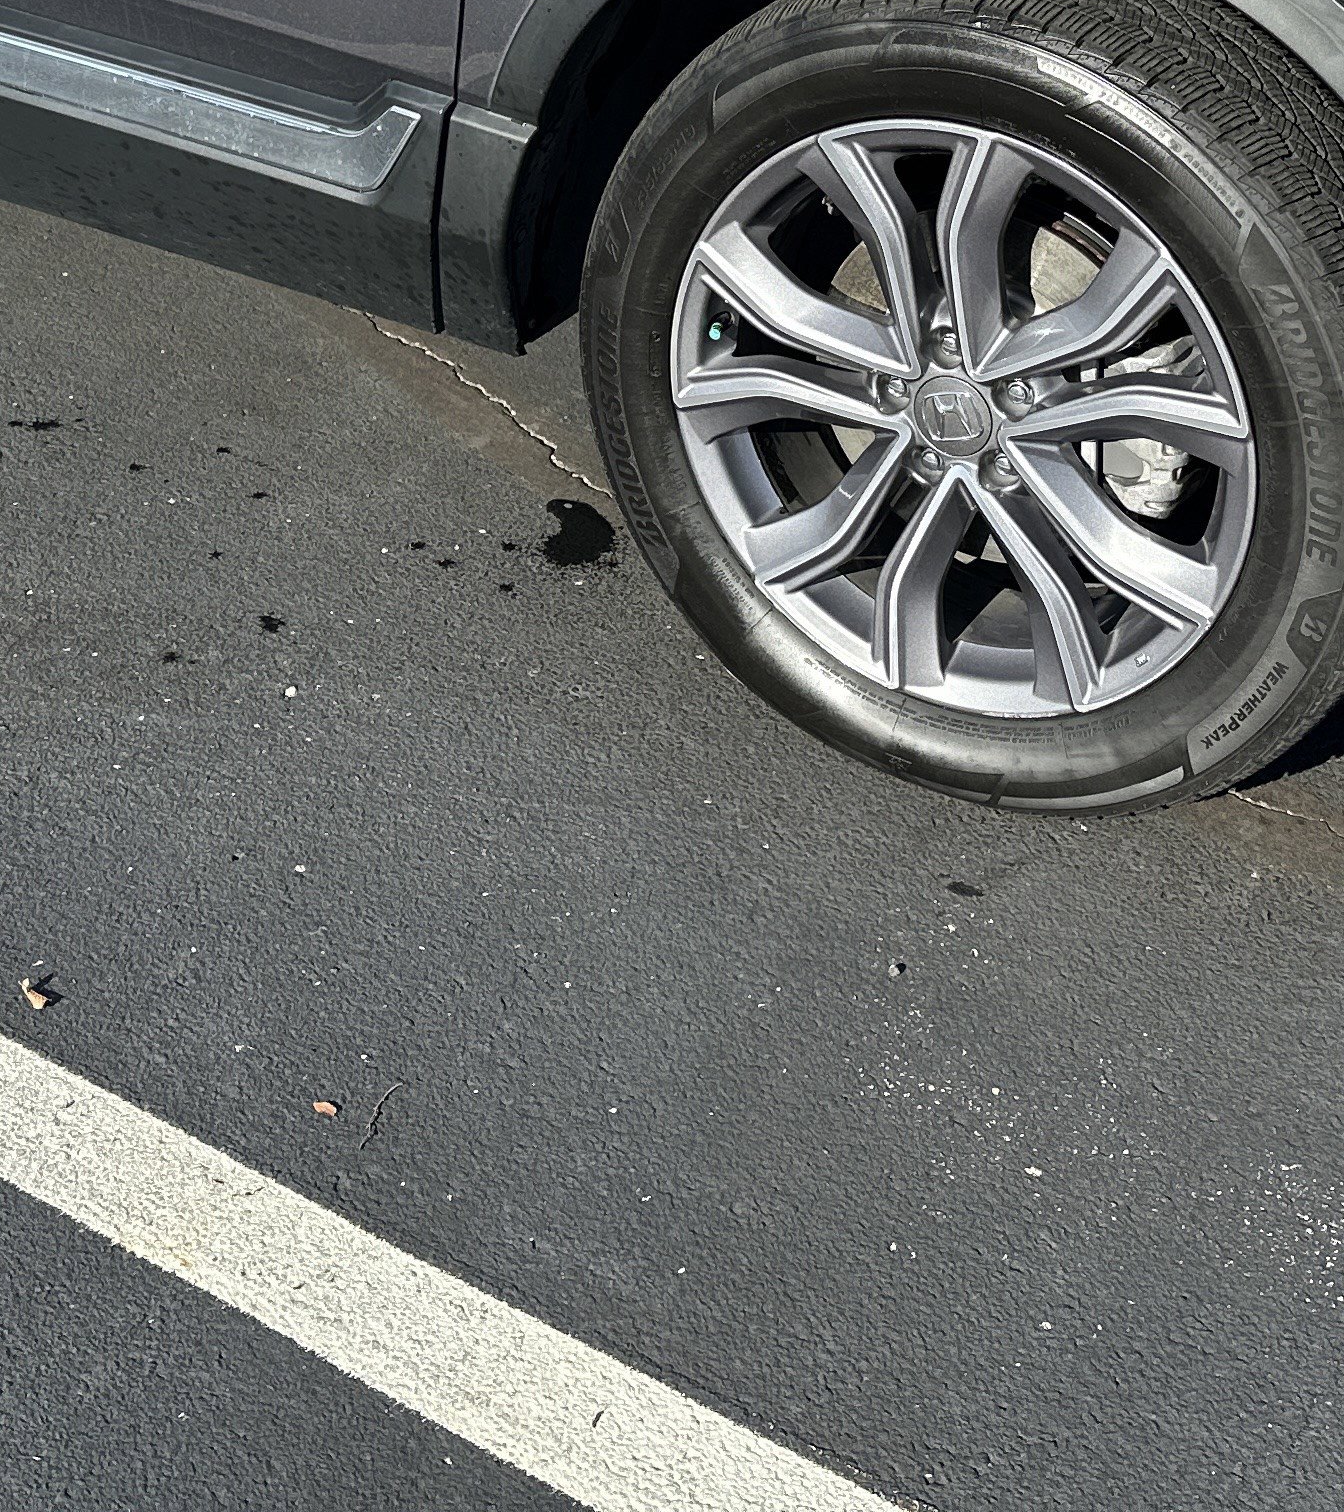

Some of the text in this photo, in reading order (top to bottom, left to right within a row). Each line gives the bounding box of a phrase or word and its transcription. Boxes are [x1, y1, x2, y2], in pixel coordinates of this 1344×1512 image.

[594, 303, 667, 548] BRIDGESTONE
[1263, 284, 1344, 569] BRIDGESTONE
[1200, 661, 1290, 750] WEATHERPEAK
